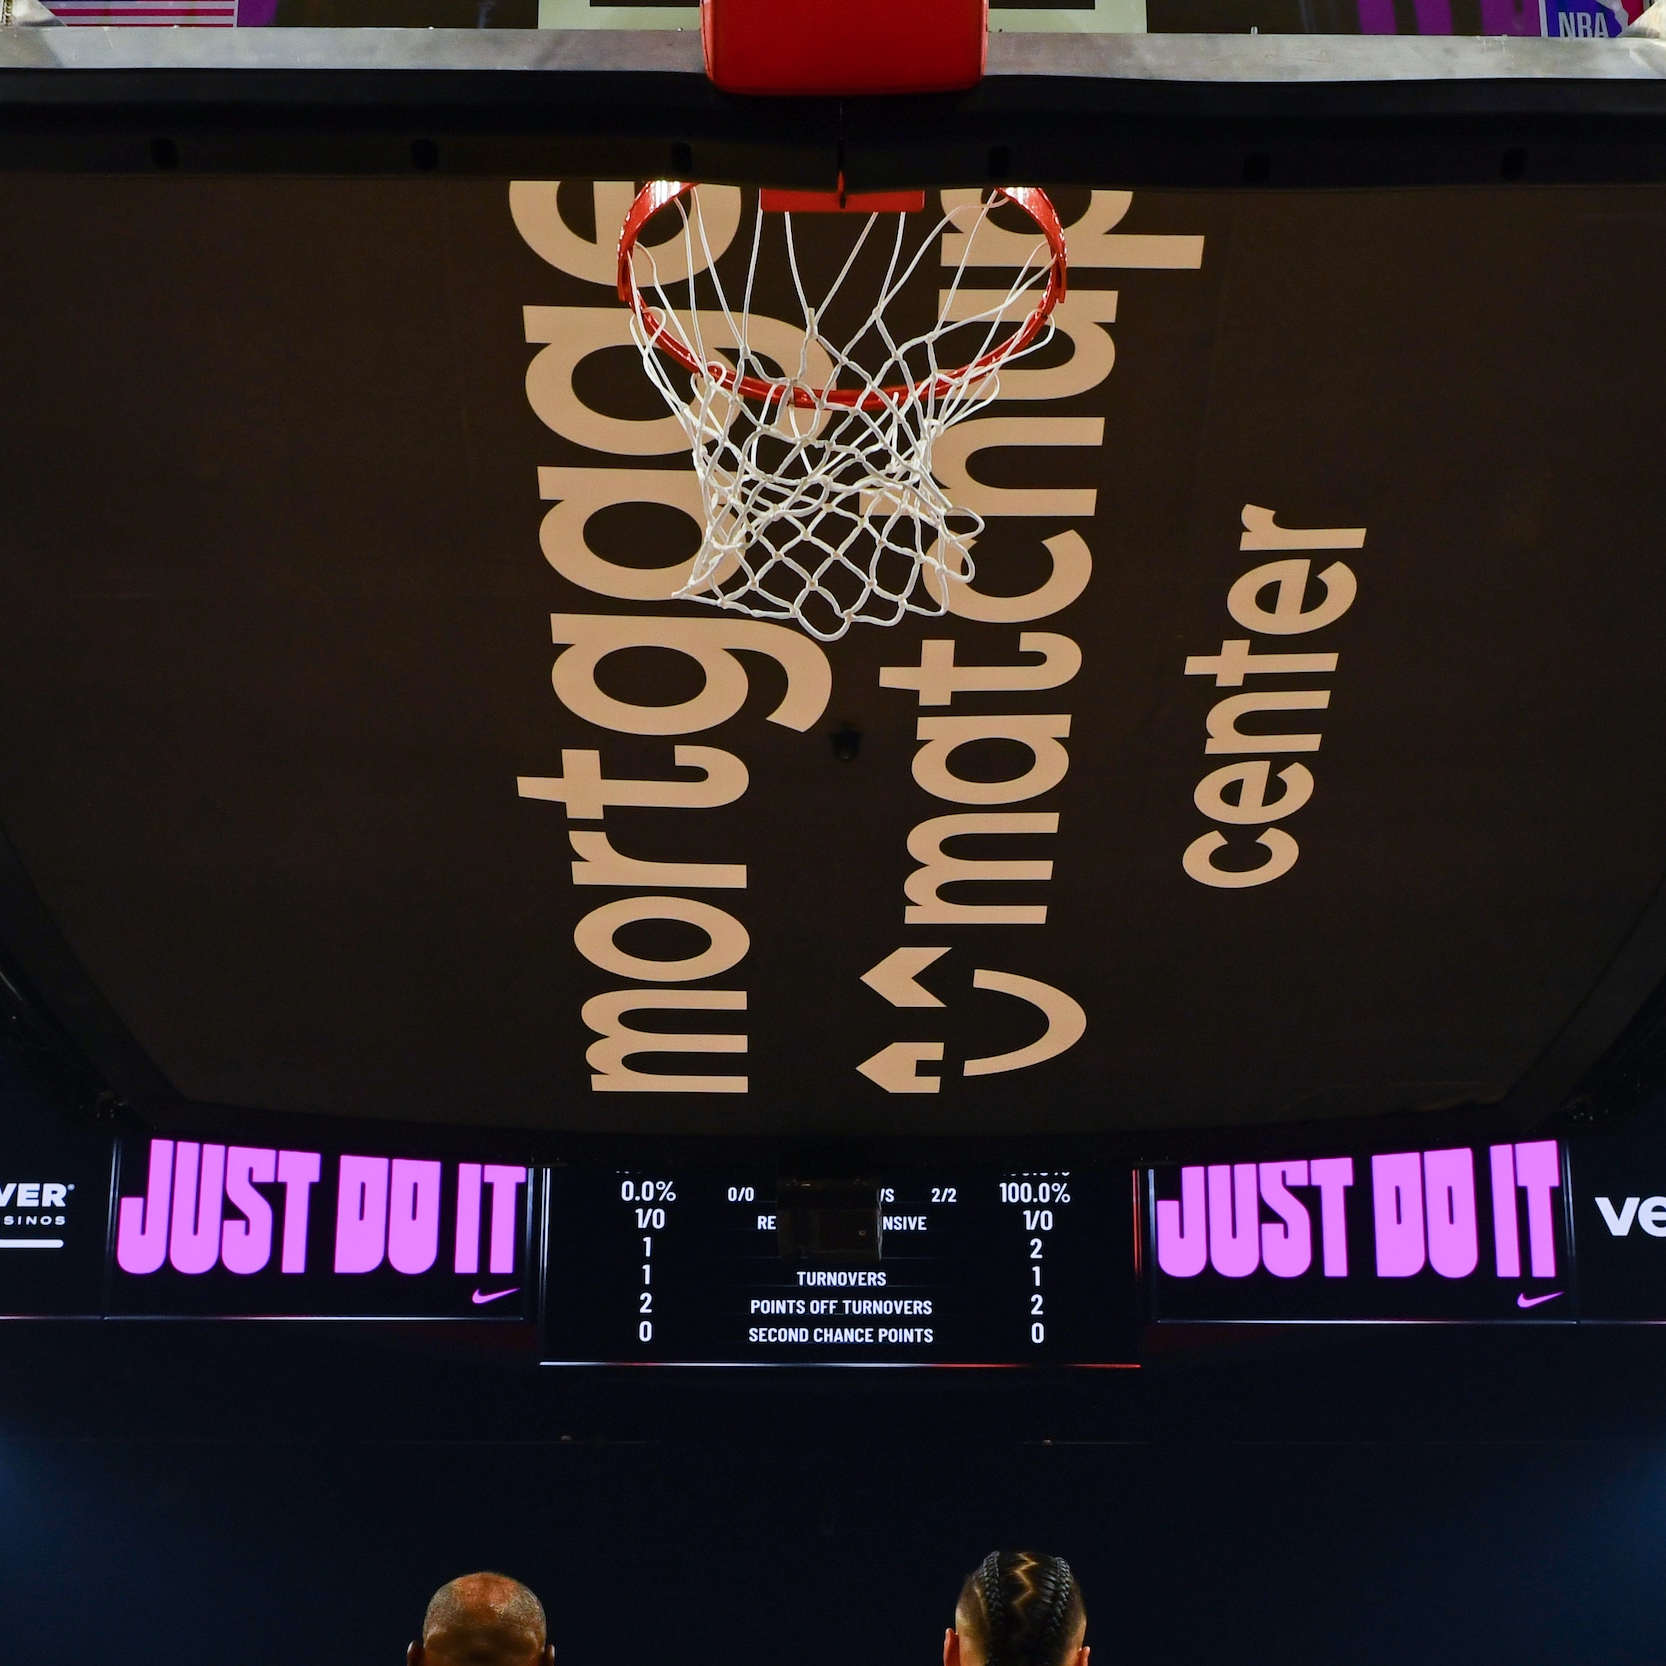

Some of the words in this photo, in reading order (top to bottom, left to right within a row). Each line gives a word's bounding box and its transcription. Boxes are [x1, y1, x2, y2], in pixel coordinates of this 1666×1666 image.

[1557, 11, 1609, 38] NBA
[509, 180, 836, 1093] mortgage
[1182, 503, 1367, 888] center
[622, 1181, 676, 1201] 0.0%
[728, 1187, 754, 1201] 0/0
[932, 1188, 956, 1202] 2/2
[1000, 1182, 1070, 1203] 100.0%
[117, 1138, 321, 1274] JUST
[334, 1155, 442, 1275] DO
[454, 1162, 526, 1274] IT
[1156, 1157, 1353, 1278] JUST
[1371, 1148, 1478, 1278] DO
[1489, 1140, 1559, 1278] IT
[635, 1208, 665, 1229] 1/0
[883, 1216, 927, 1230] NSIVE
[1023, 1210, 1053, 1230] 1/0
[643, 1237, 651, 1257] 1
[1030, 1238, 1042, 1258] 2
[643, 1265, 650, 1284] 1
[797, 1272, 886, 1286] TURNOVERS
[1032, 1266, 1040, 1286] 1
[640, 1293, 652, 1313] 2
[751, 1300, 805, 1314] POINTS
[810, 1300, 838, 1314] OFF
[842, 1300, 932, 1315] TURNOVERS
[1031, 1294, 1043, 1315] 2
[639, 1321, 652, 1342] 0
[749, 1328, 808, 1342] SECOND
[814, 1328, 873, 1343] CHANCE
[879, 1328, 933, 1343] POINTS
[1032, 1323, 1044, 1343] 0
